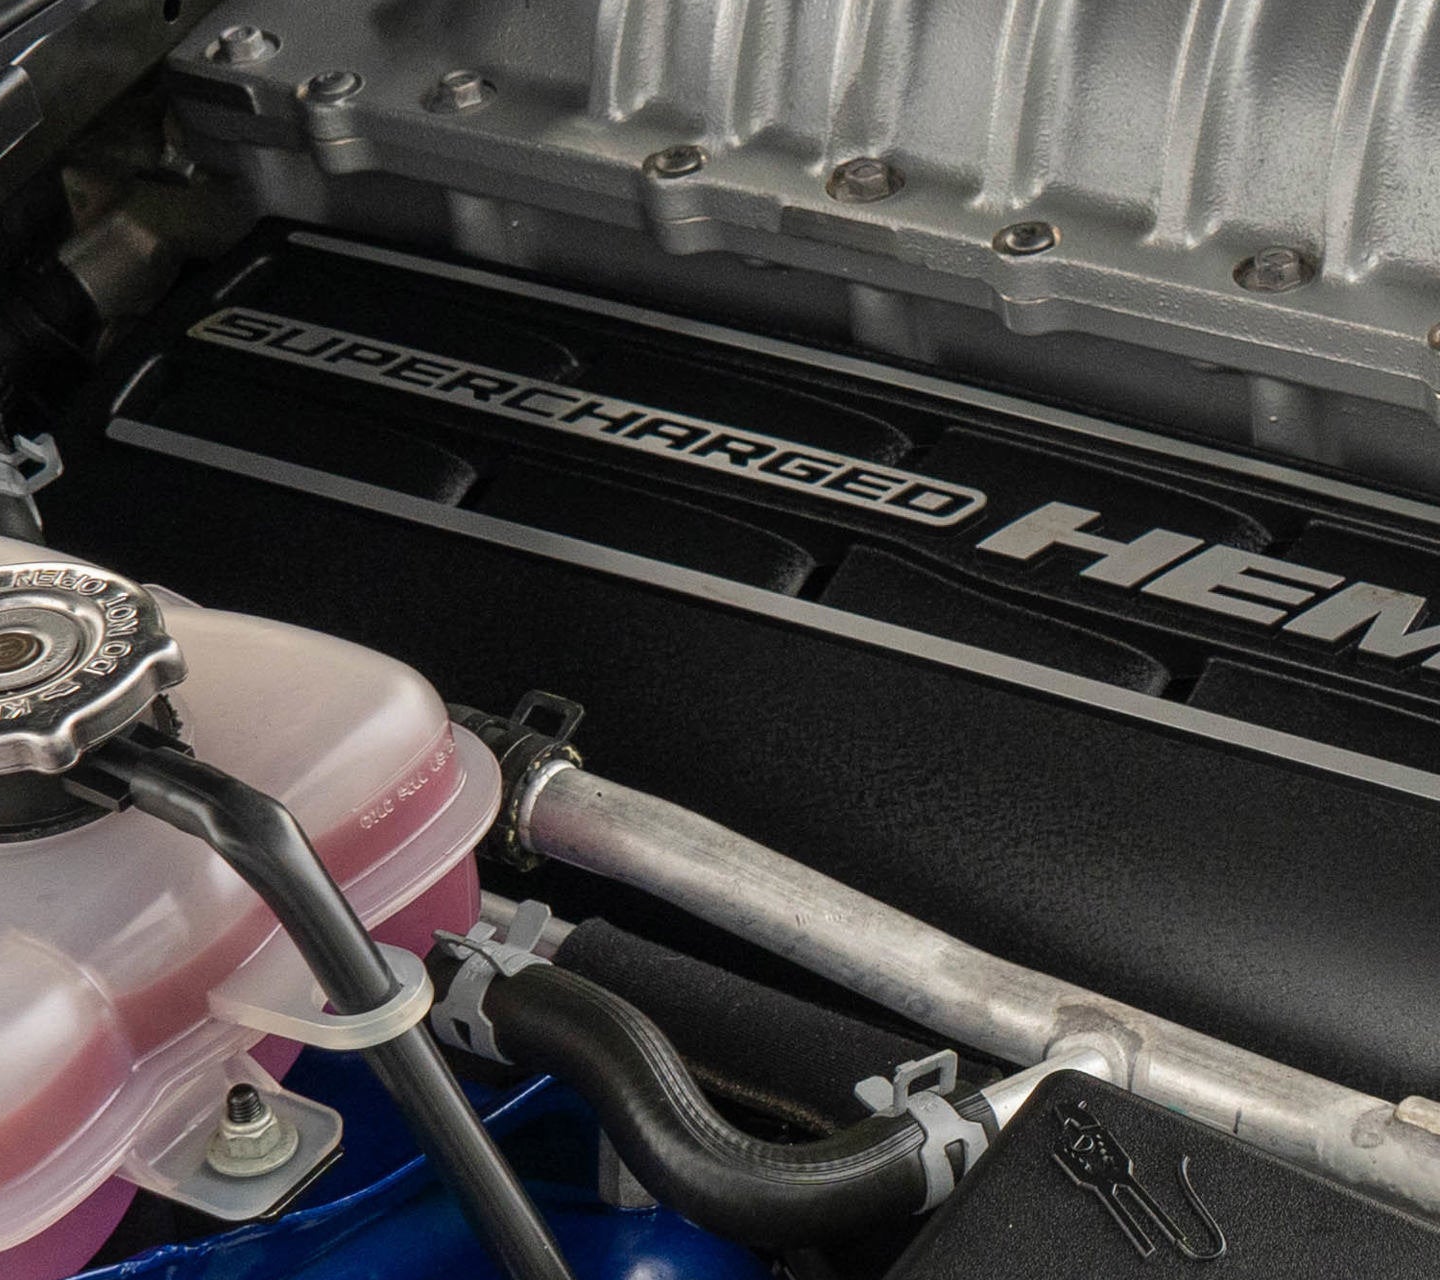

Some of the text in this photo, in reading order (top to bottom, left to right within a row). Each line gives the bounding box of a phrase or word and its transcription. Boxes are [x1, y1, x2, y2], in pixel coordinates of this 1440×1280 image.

[194, 310, 970, 521] SUPERCHARGED
[11, 569, 108, 596] OPEN
[105, 592, 140, 638] NOT
[84, 640, 133, 677] DO
